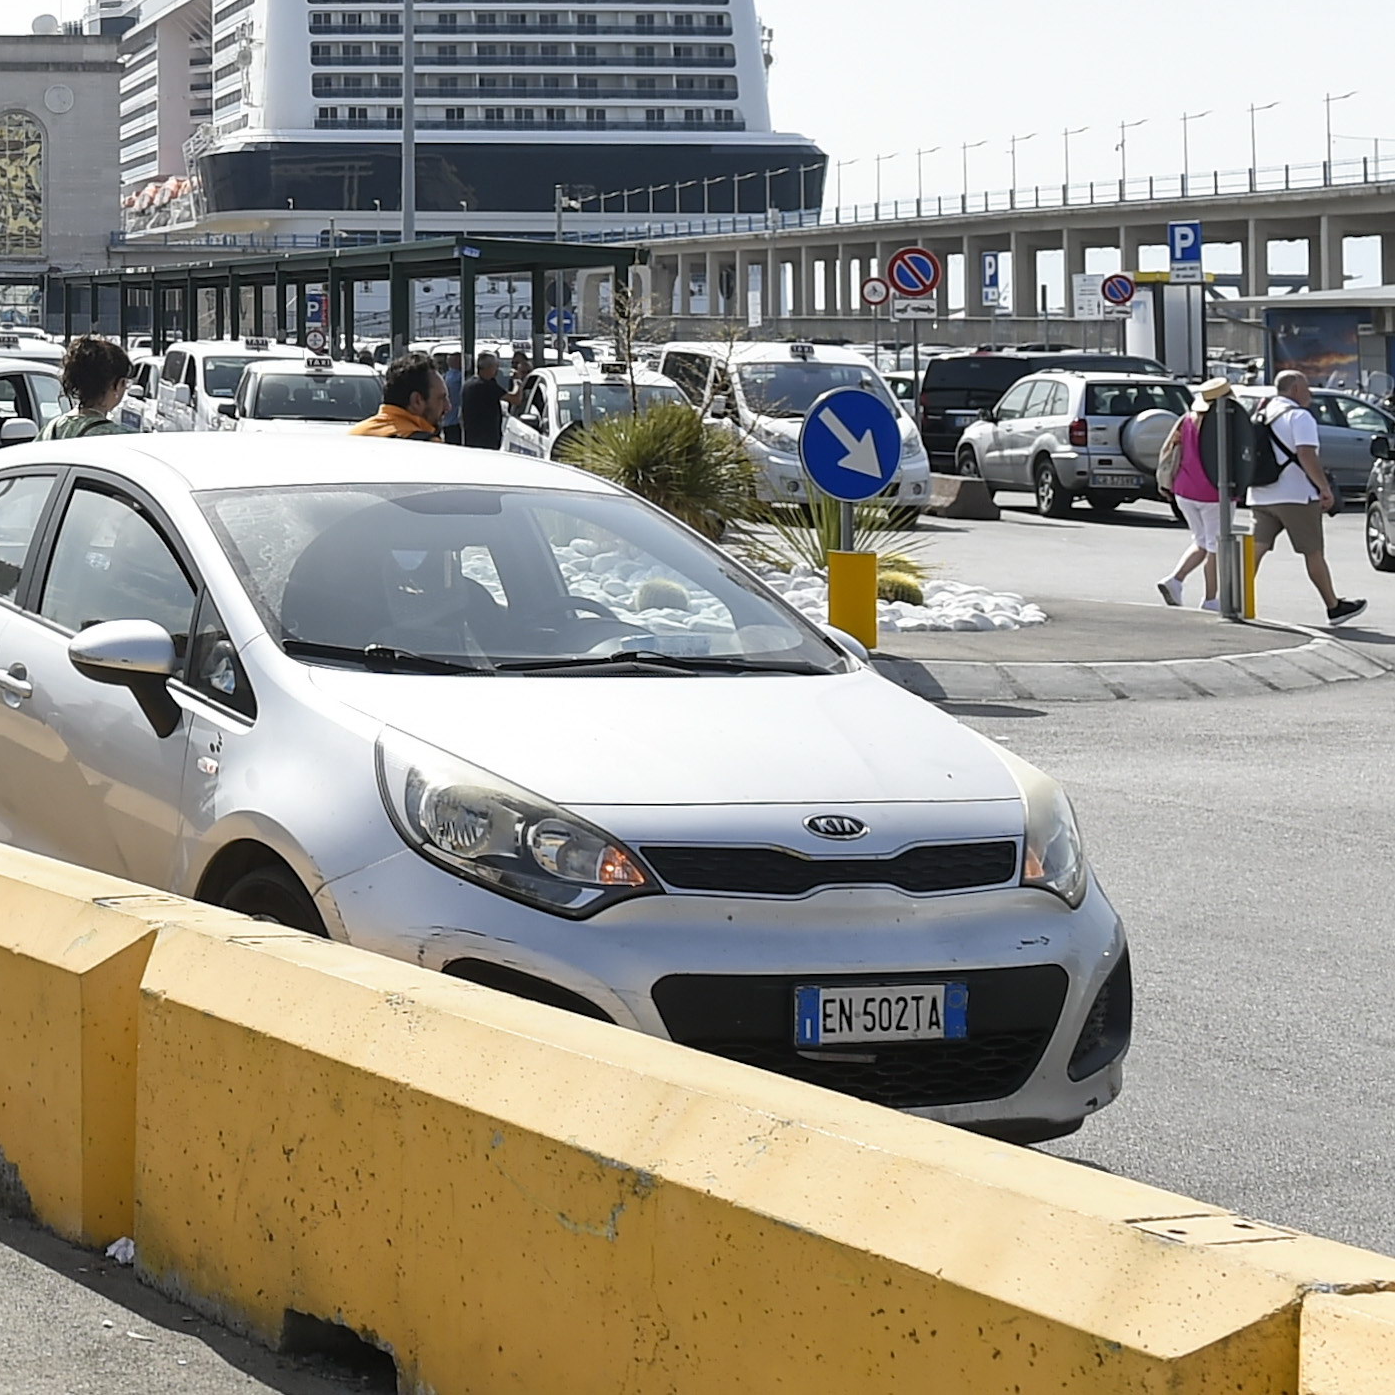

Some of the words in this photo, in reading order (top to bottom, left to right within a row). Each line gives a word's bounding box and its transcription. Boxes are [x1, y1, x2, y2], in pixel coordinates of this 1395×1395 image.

[1174, 226, 1195, 259] P
[985, 255, 995, 285] P
[307, 301, 319, 317] P
[308, 358, 331, 366] TAXI
[813, 817, 860, 834] KIA
